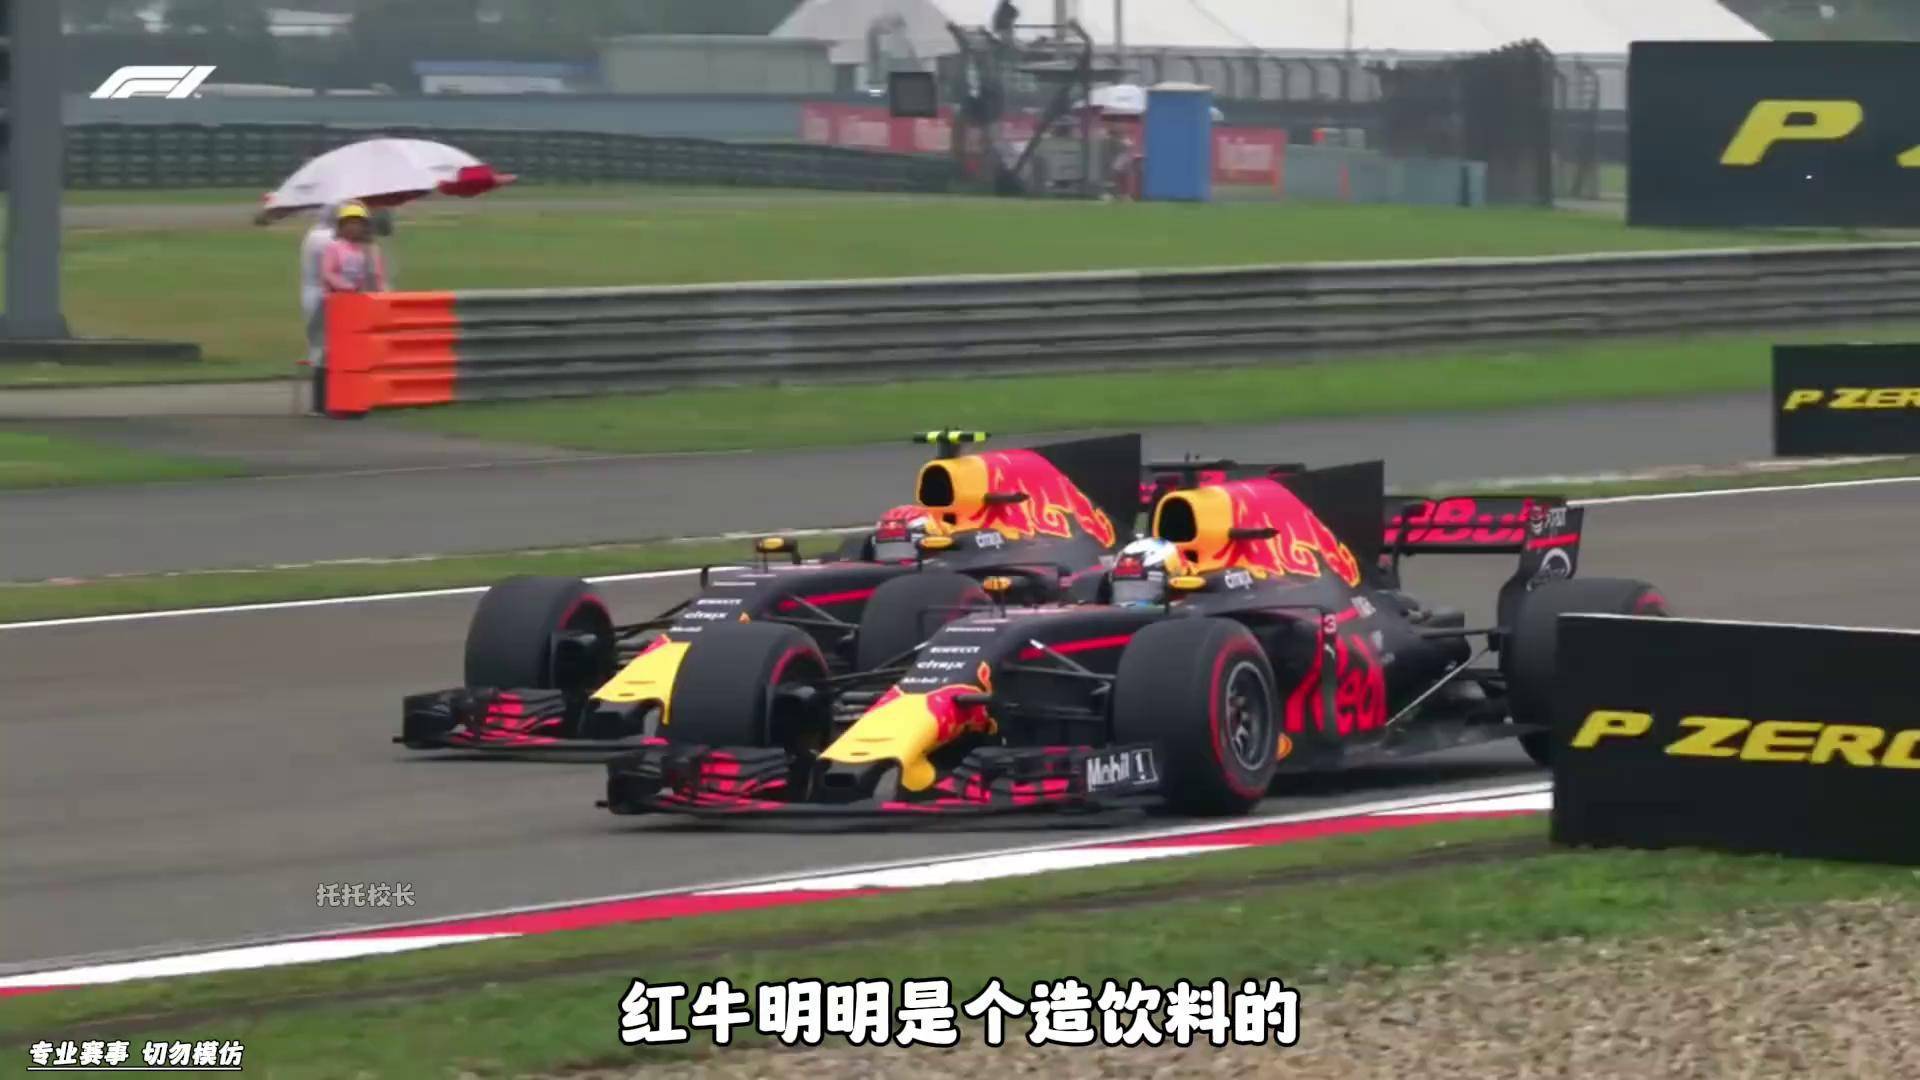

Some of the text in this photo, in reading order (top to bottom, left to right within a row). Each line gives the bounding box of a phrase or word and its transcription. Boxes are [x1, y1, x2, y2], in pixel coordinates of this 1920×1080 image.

[1720, 99, 1864, 165] P
[1783, 389, 1825, 410] P
[1323, 614, 1338, 634] 3
[1570, 709, 1654, 748] P
[1086, 751, 1129, 792] Mobil
